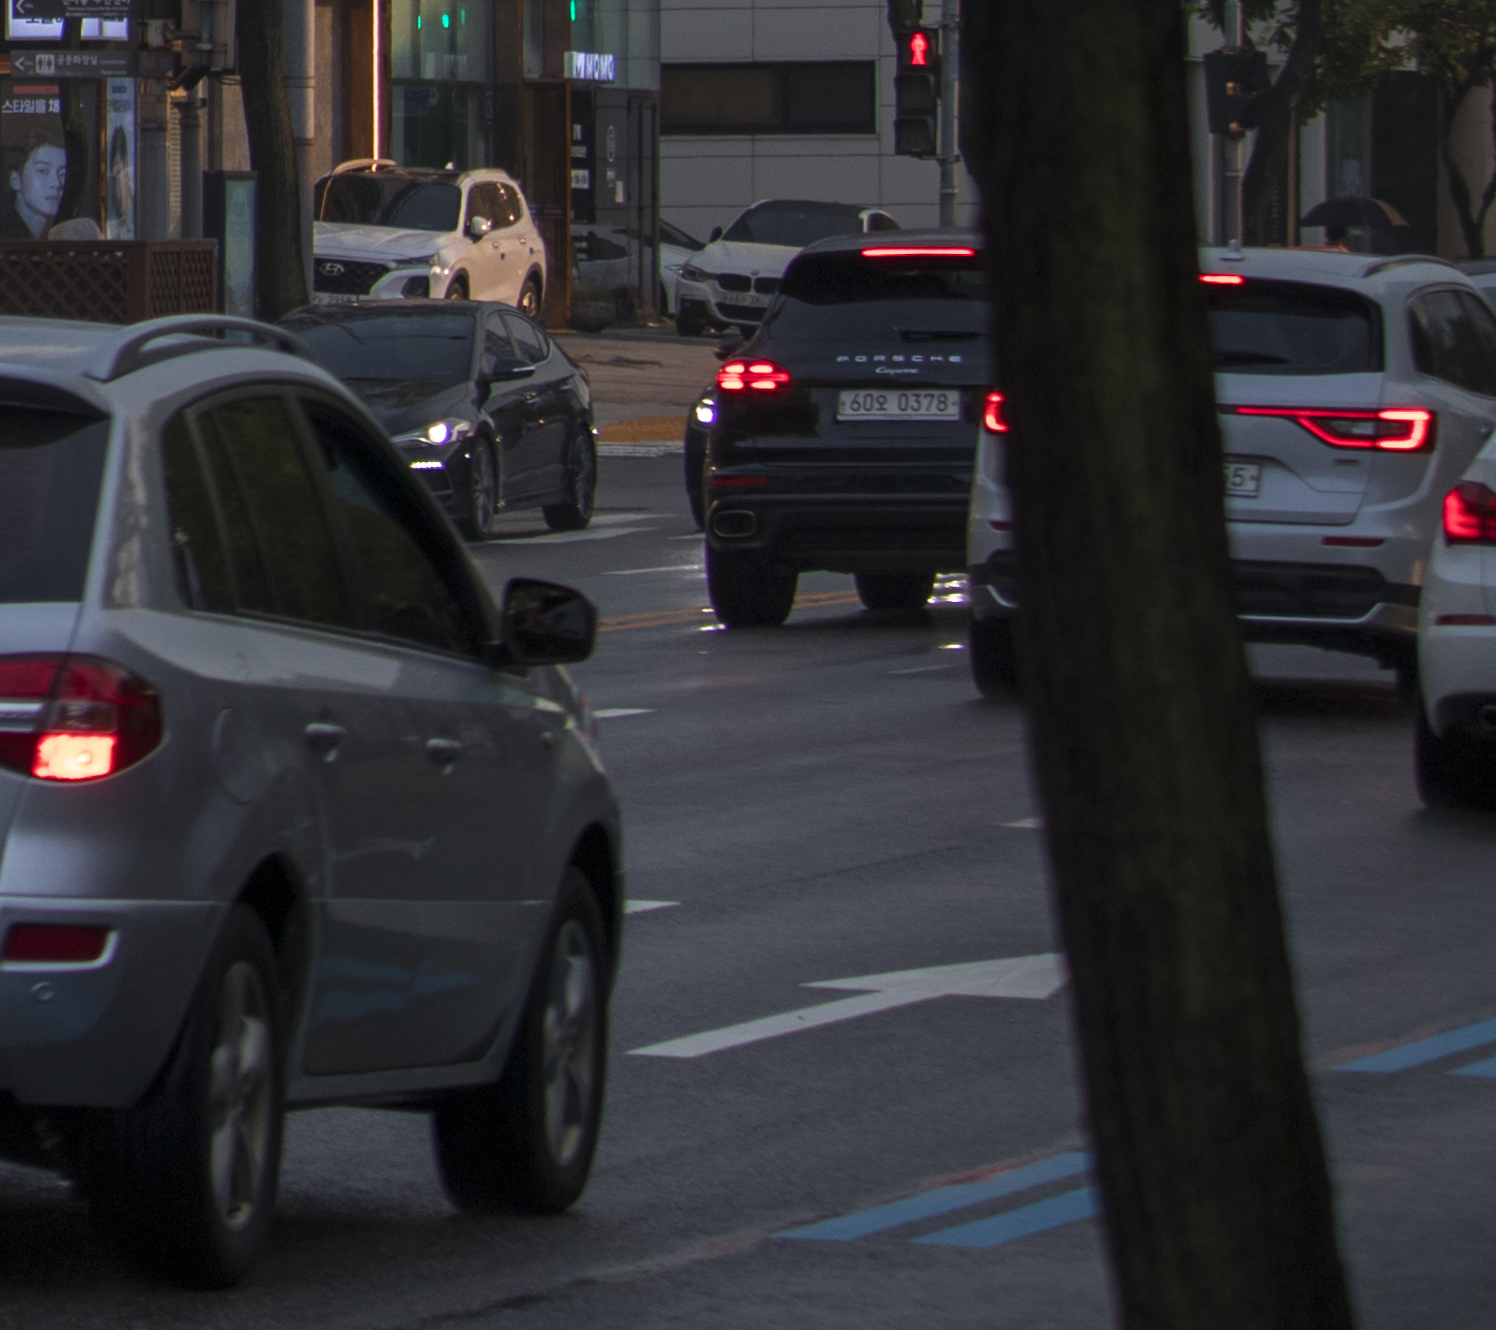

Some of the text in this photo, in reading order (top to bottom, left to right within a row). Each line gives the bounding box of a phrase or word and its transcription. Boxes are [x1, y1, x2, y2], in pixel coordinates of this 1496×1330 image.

[835, 354, 964, 363] PORSCHE
[849, 392, 949, 412] 60오 0378
